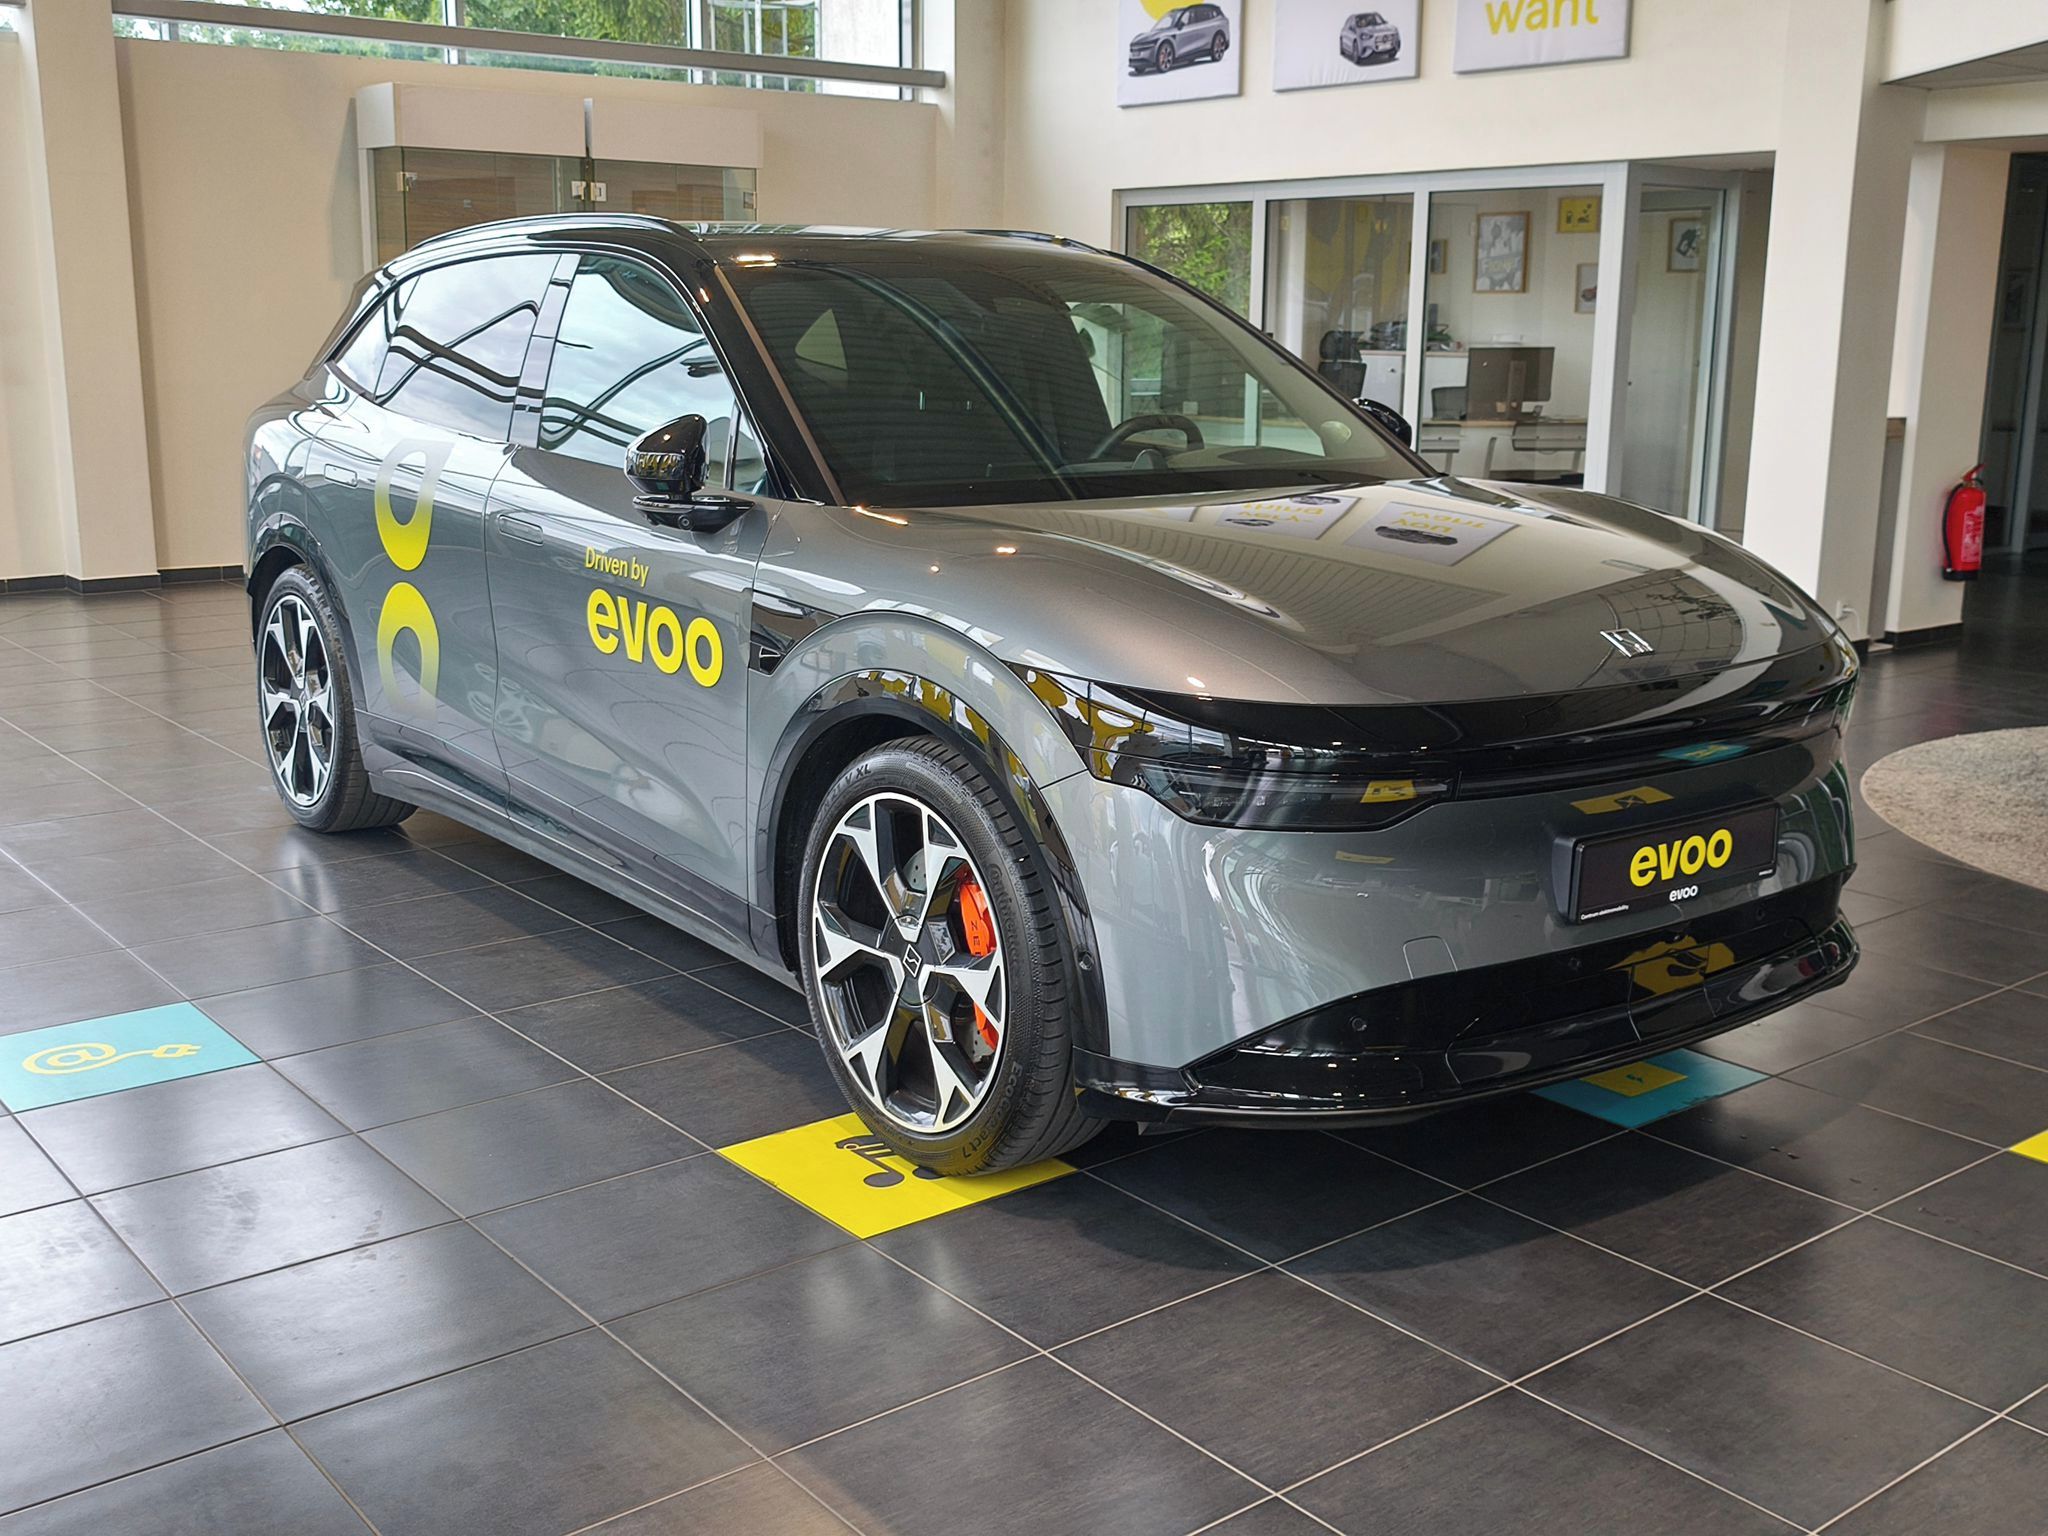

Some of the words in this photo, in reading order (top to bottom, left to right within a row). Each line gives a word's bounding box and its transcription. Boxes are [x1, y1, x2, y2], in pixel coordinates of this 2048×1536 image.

[1485, 0, 1599, 35] want
[584, 546, 628, 578] Driven
[631, 556, 650, 588] by
[586, 588, 724, 688] evoo
[1629, 828, 1733, 887] evoo
[1668, 884, 1699, 902] evoo
